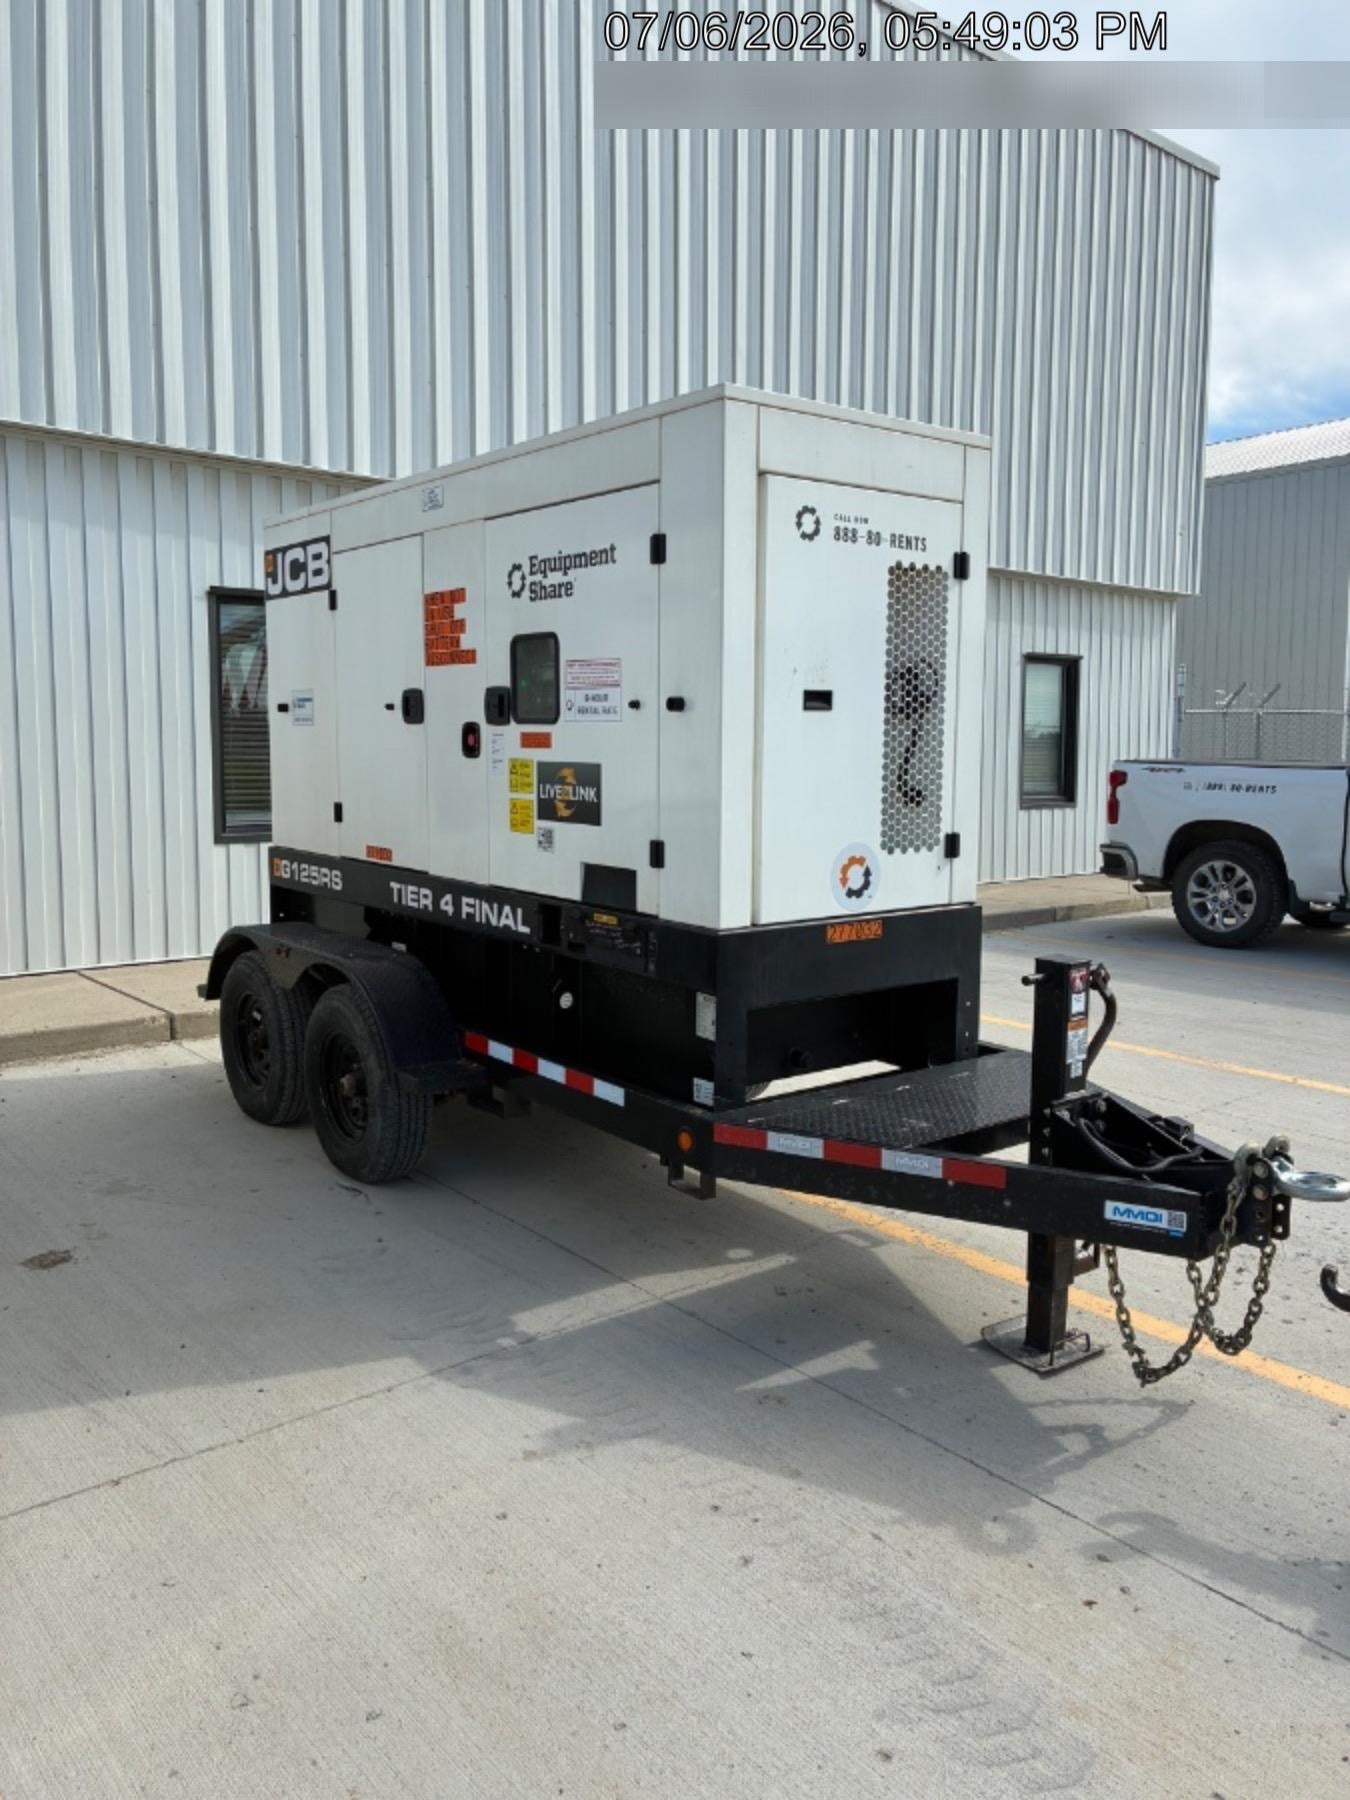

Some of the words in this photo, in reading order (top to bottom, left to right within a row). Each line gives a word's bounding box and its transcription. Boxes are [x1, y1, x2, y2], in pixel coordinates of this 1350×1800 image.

[833, 513, 851, 523] CALL
[267, 541, 329, 595] JCB
[528, 543, 616, 579] Equipment
[528, 580, 573, 602] Share
[272, 857, 343, 891] DG125RS
[390, 881, 433, 912] TIER
[439, 893, 454, 917] 4
[461, 896, 531, 934] FINAL
